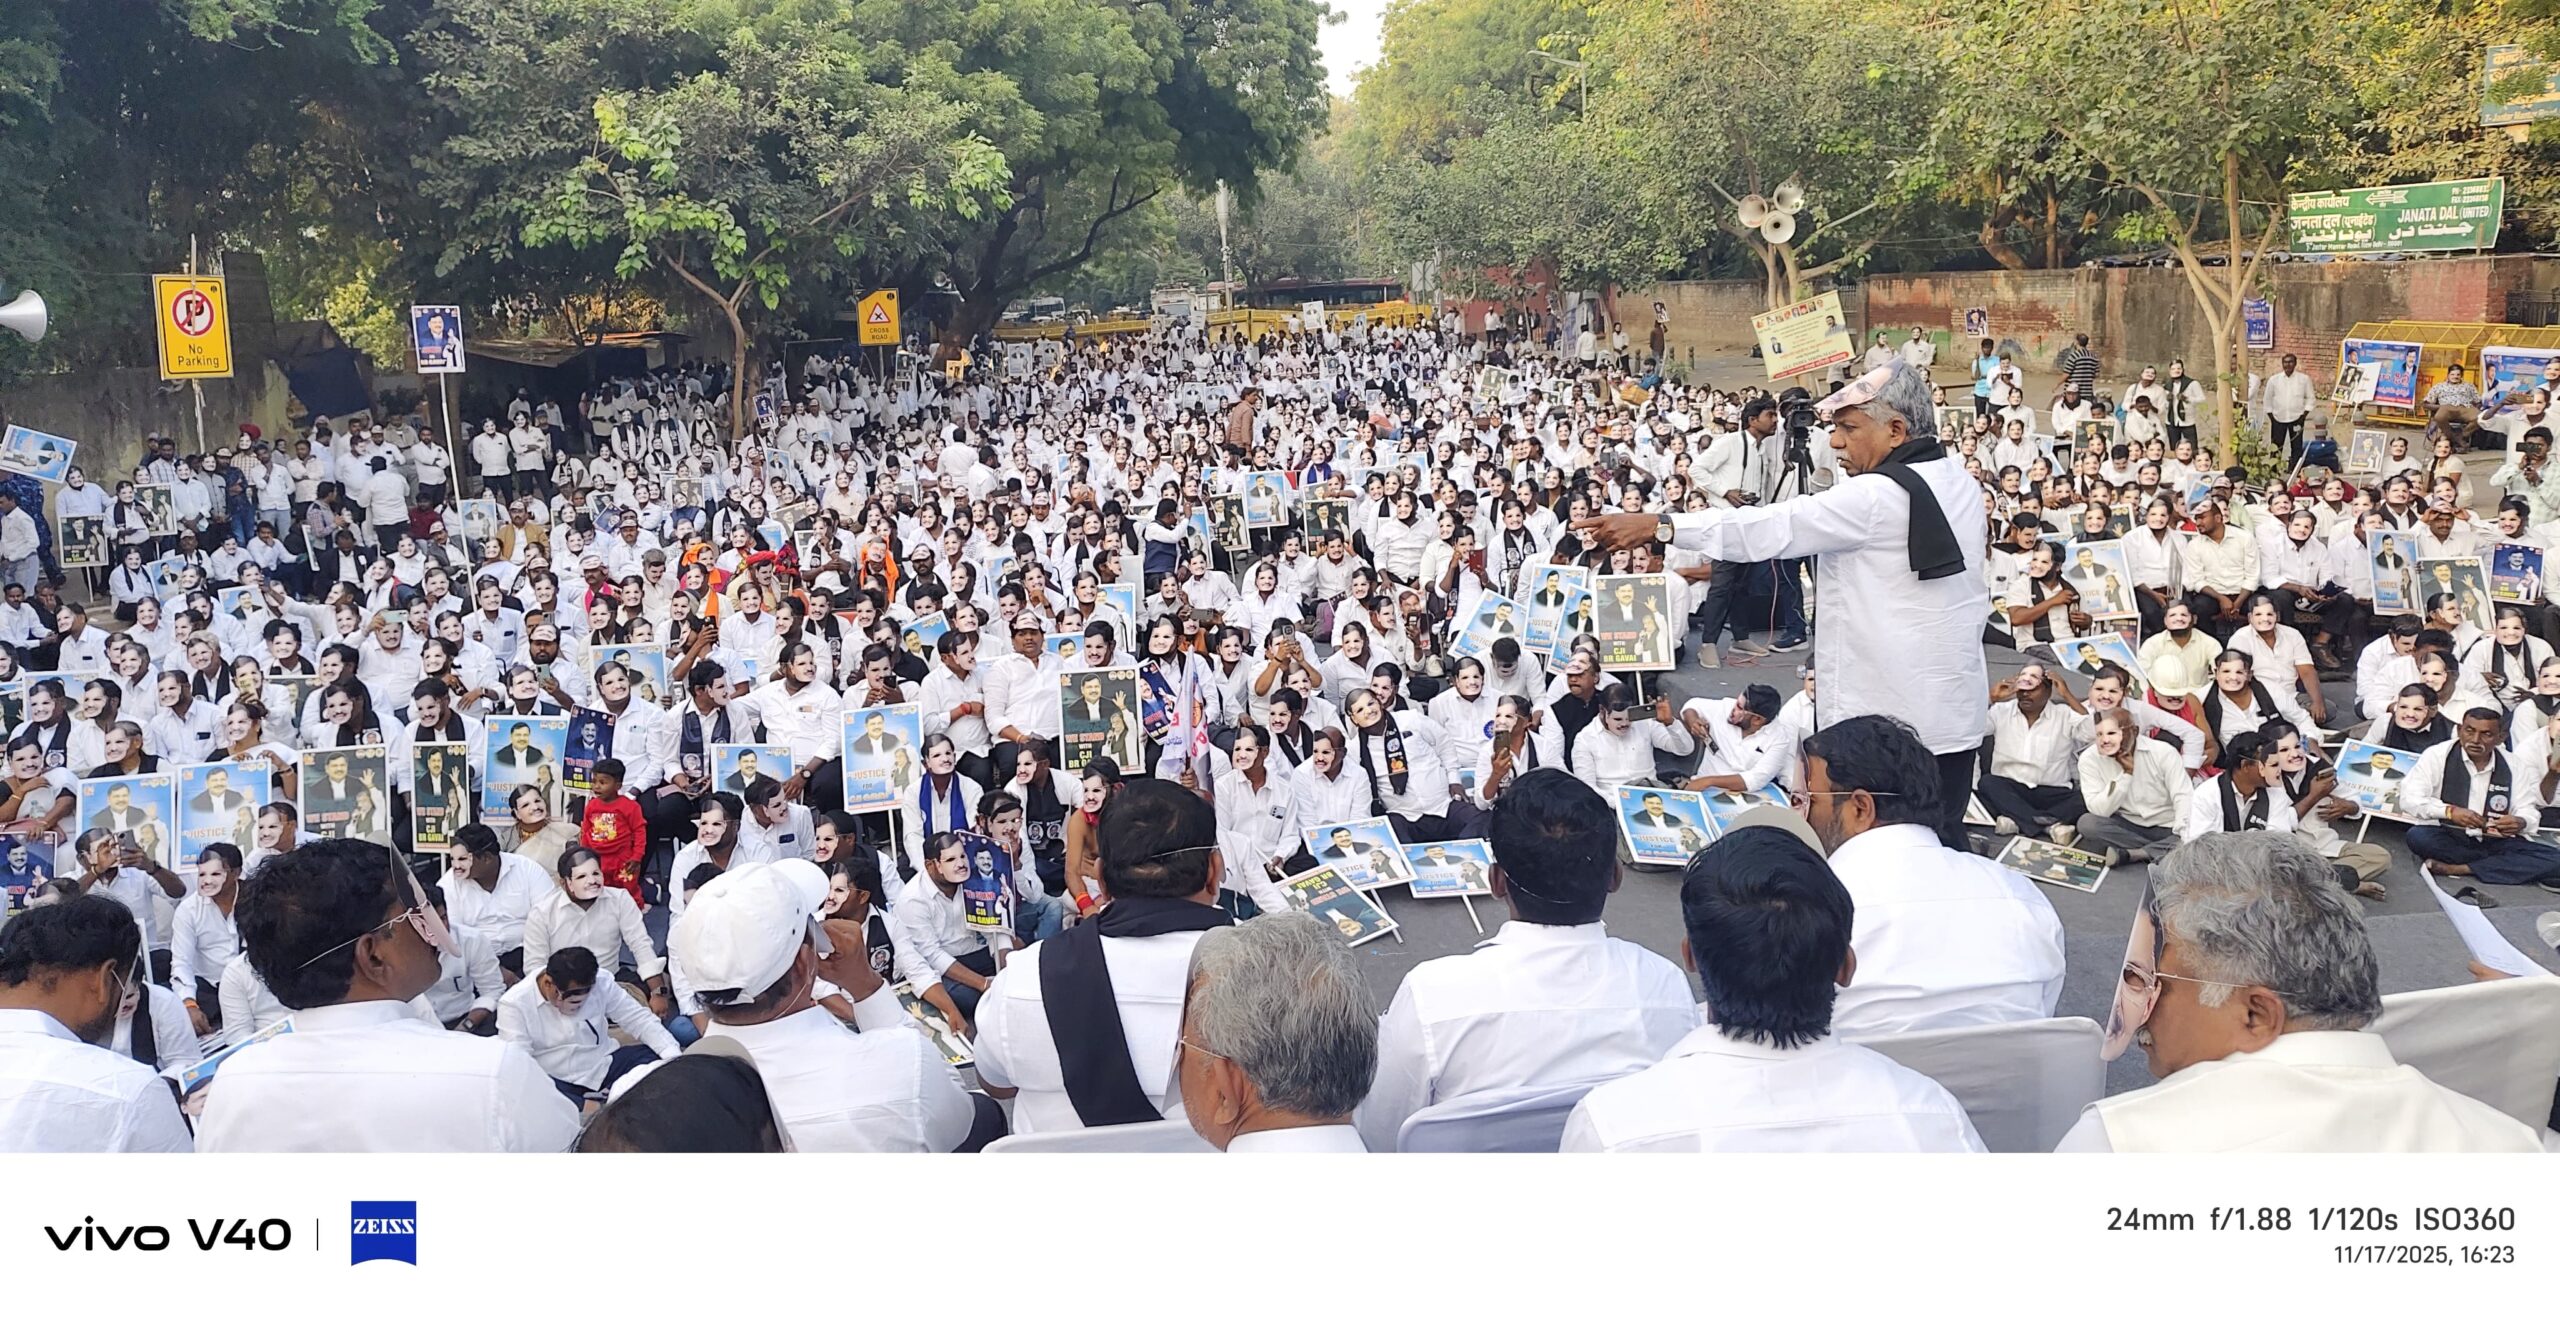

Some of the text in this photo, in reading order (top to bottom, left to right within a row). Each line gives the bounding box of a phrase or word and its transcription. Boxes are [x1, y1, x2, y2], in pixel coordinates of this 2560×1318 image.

[2398, 203, 2492, 223] JANATA DAL (UNITED)
[2291, 215, 2322, 229] जनता
[2323, 214, 2341, 229] दल
[188, 344, 202, 354] No
[178, 355, 219, 368] Parking
[1615, 654, 1637, 662] GAVAI
[1079, 750, 1092, 759] CJI
[1068, 759, 1080, 768] BR
[1296, 876, 1321, 889] GAVAI
[1312, 881, 1328, 890] CJI
